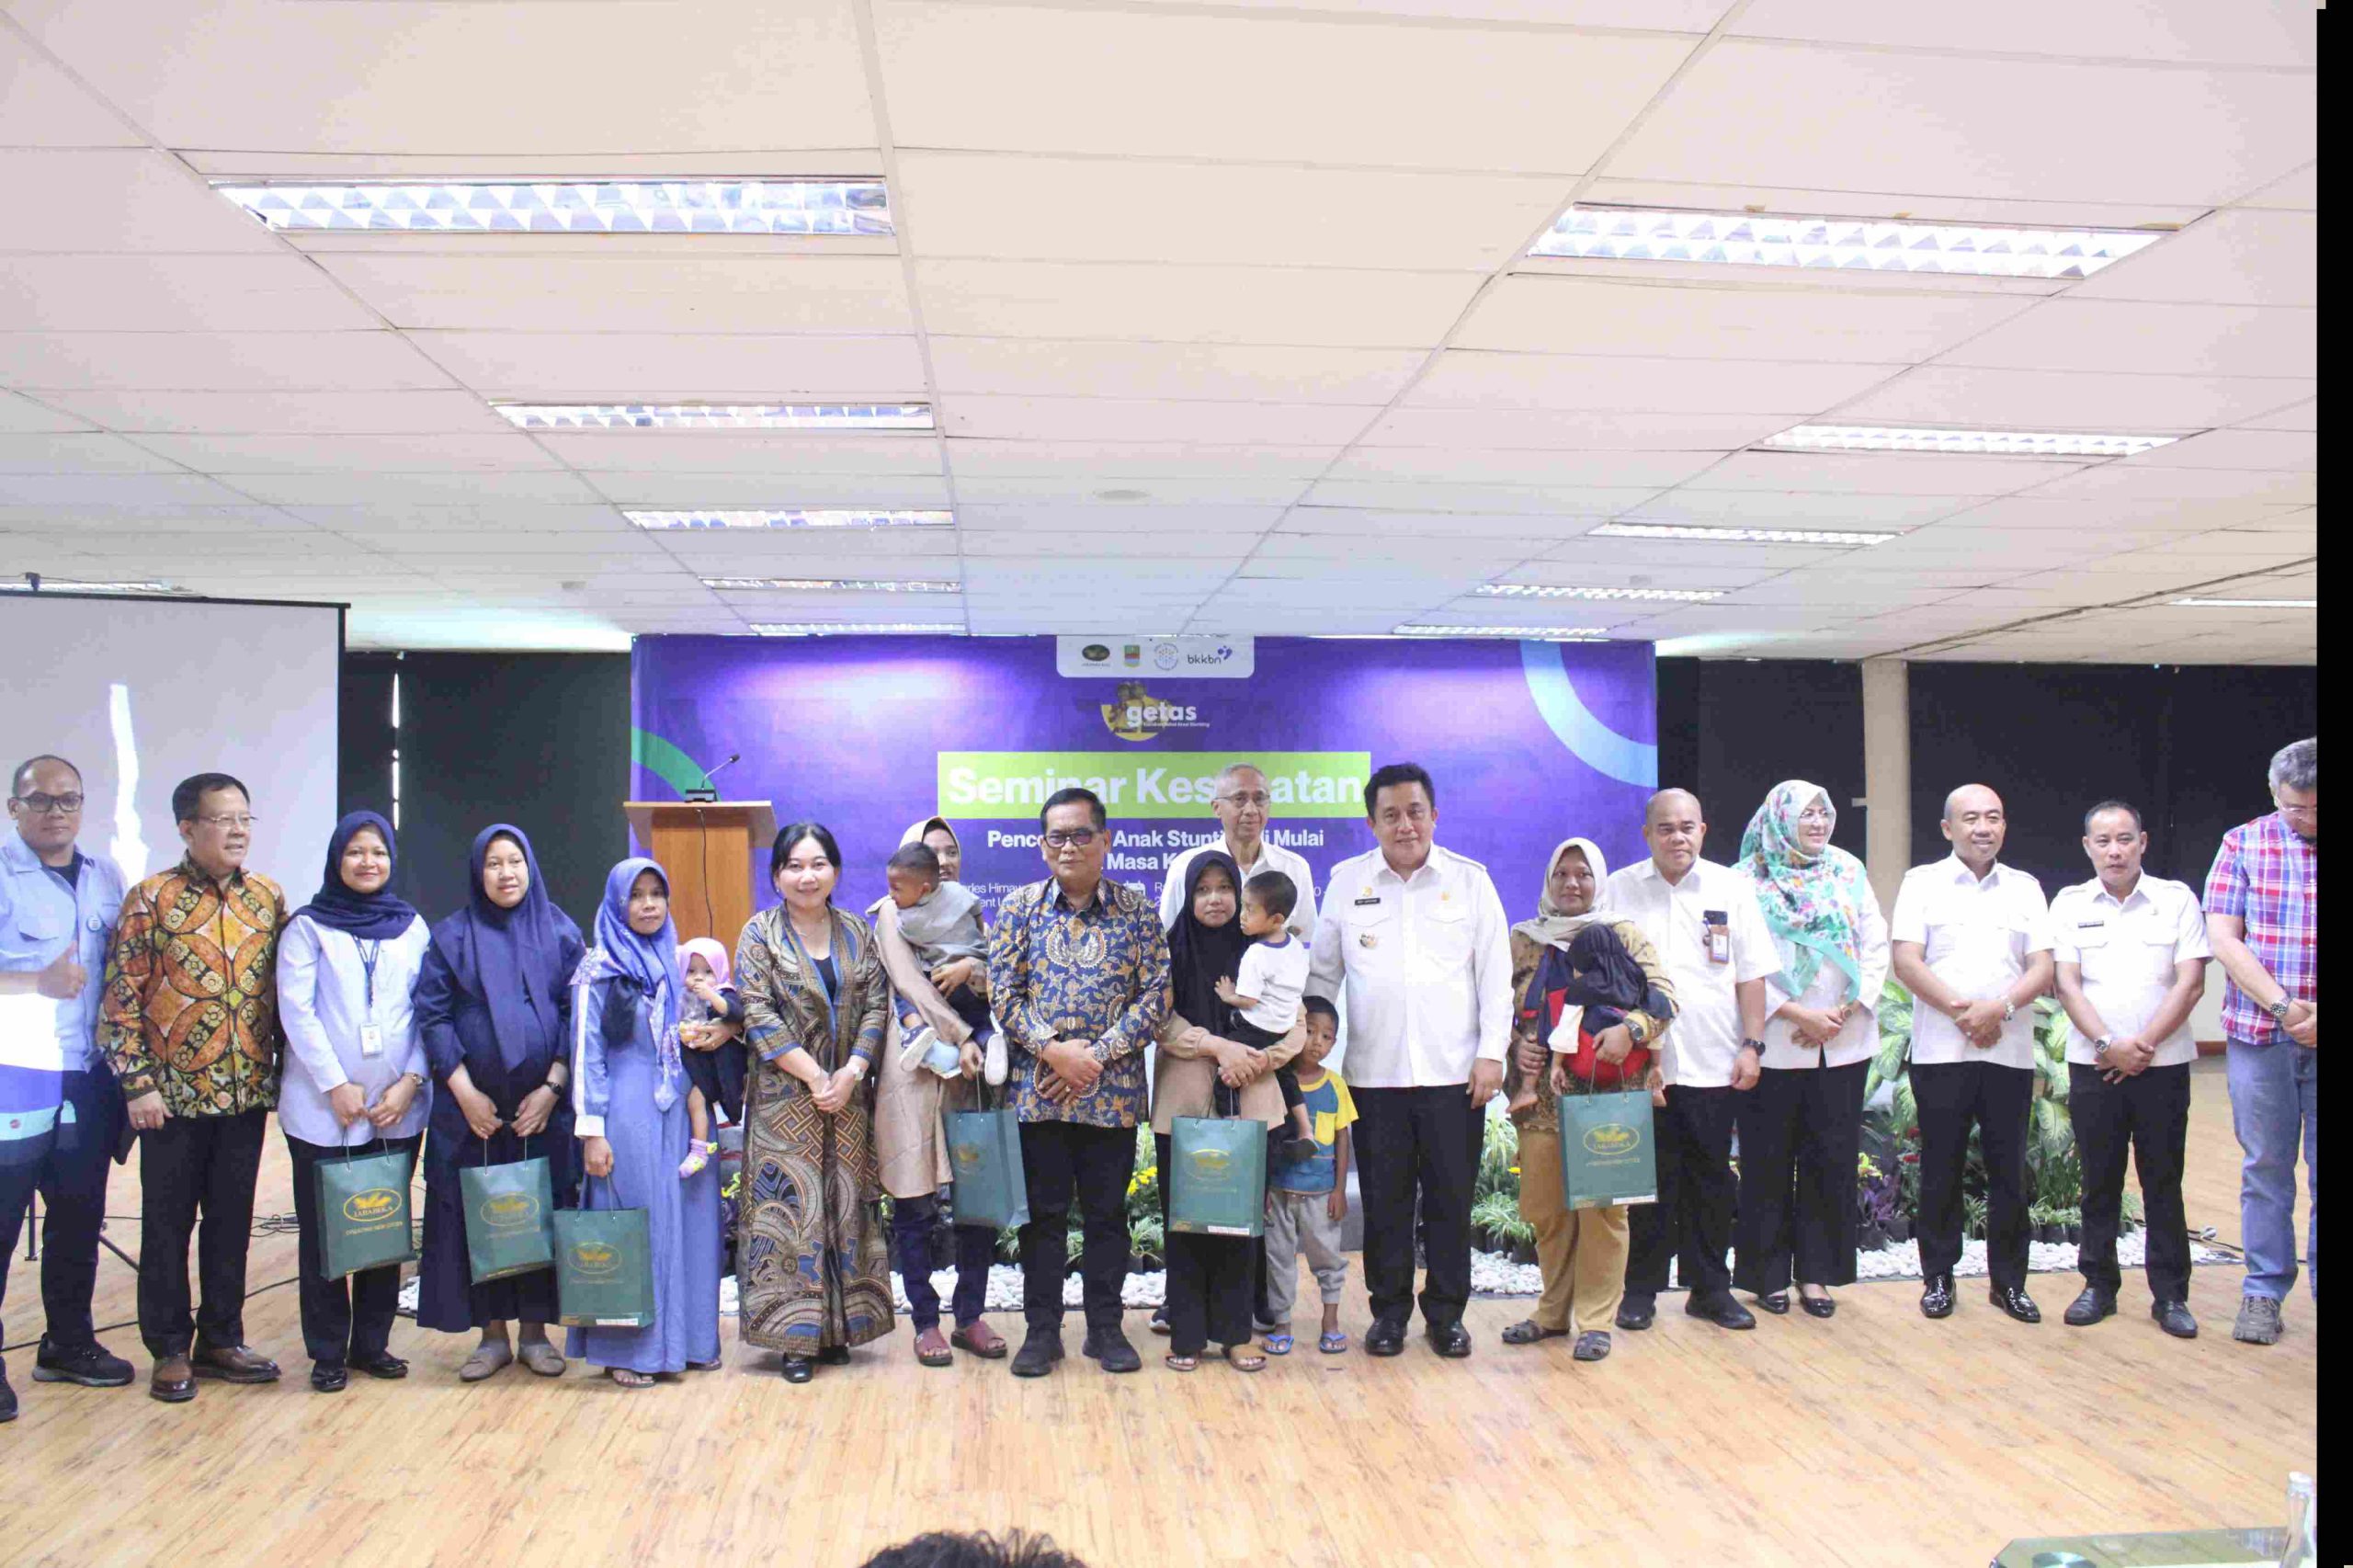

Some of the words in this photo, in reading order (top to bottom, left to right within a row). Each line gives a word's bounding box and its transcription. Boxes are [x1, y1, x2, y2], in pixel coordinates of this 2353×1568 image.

[1188, 654, 1222, 665] bkkbn
[1126, 702, 1197, 727] getas
[1136, 767, 1361, 804] Kesatan
[1112, 830, 1164, 846] Anak
[1166, 830, 1223, 846] Stunt
[1273, 829, 1324, 846] Mulai
[1107, 853, 1159, 869] Masa
